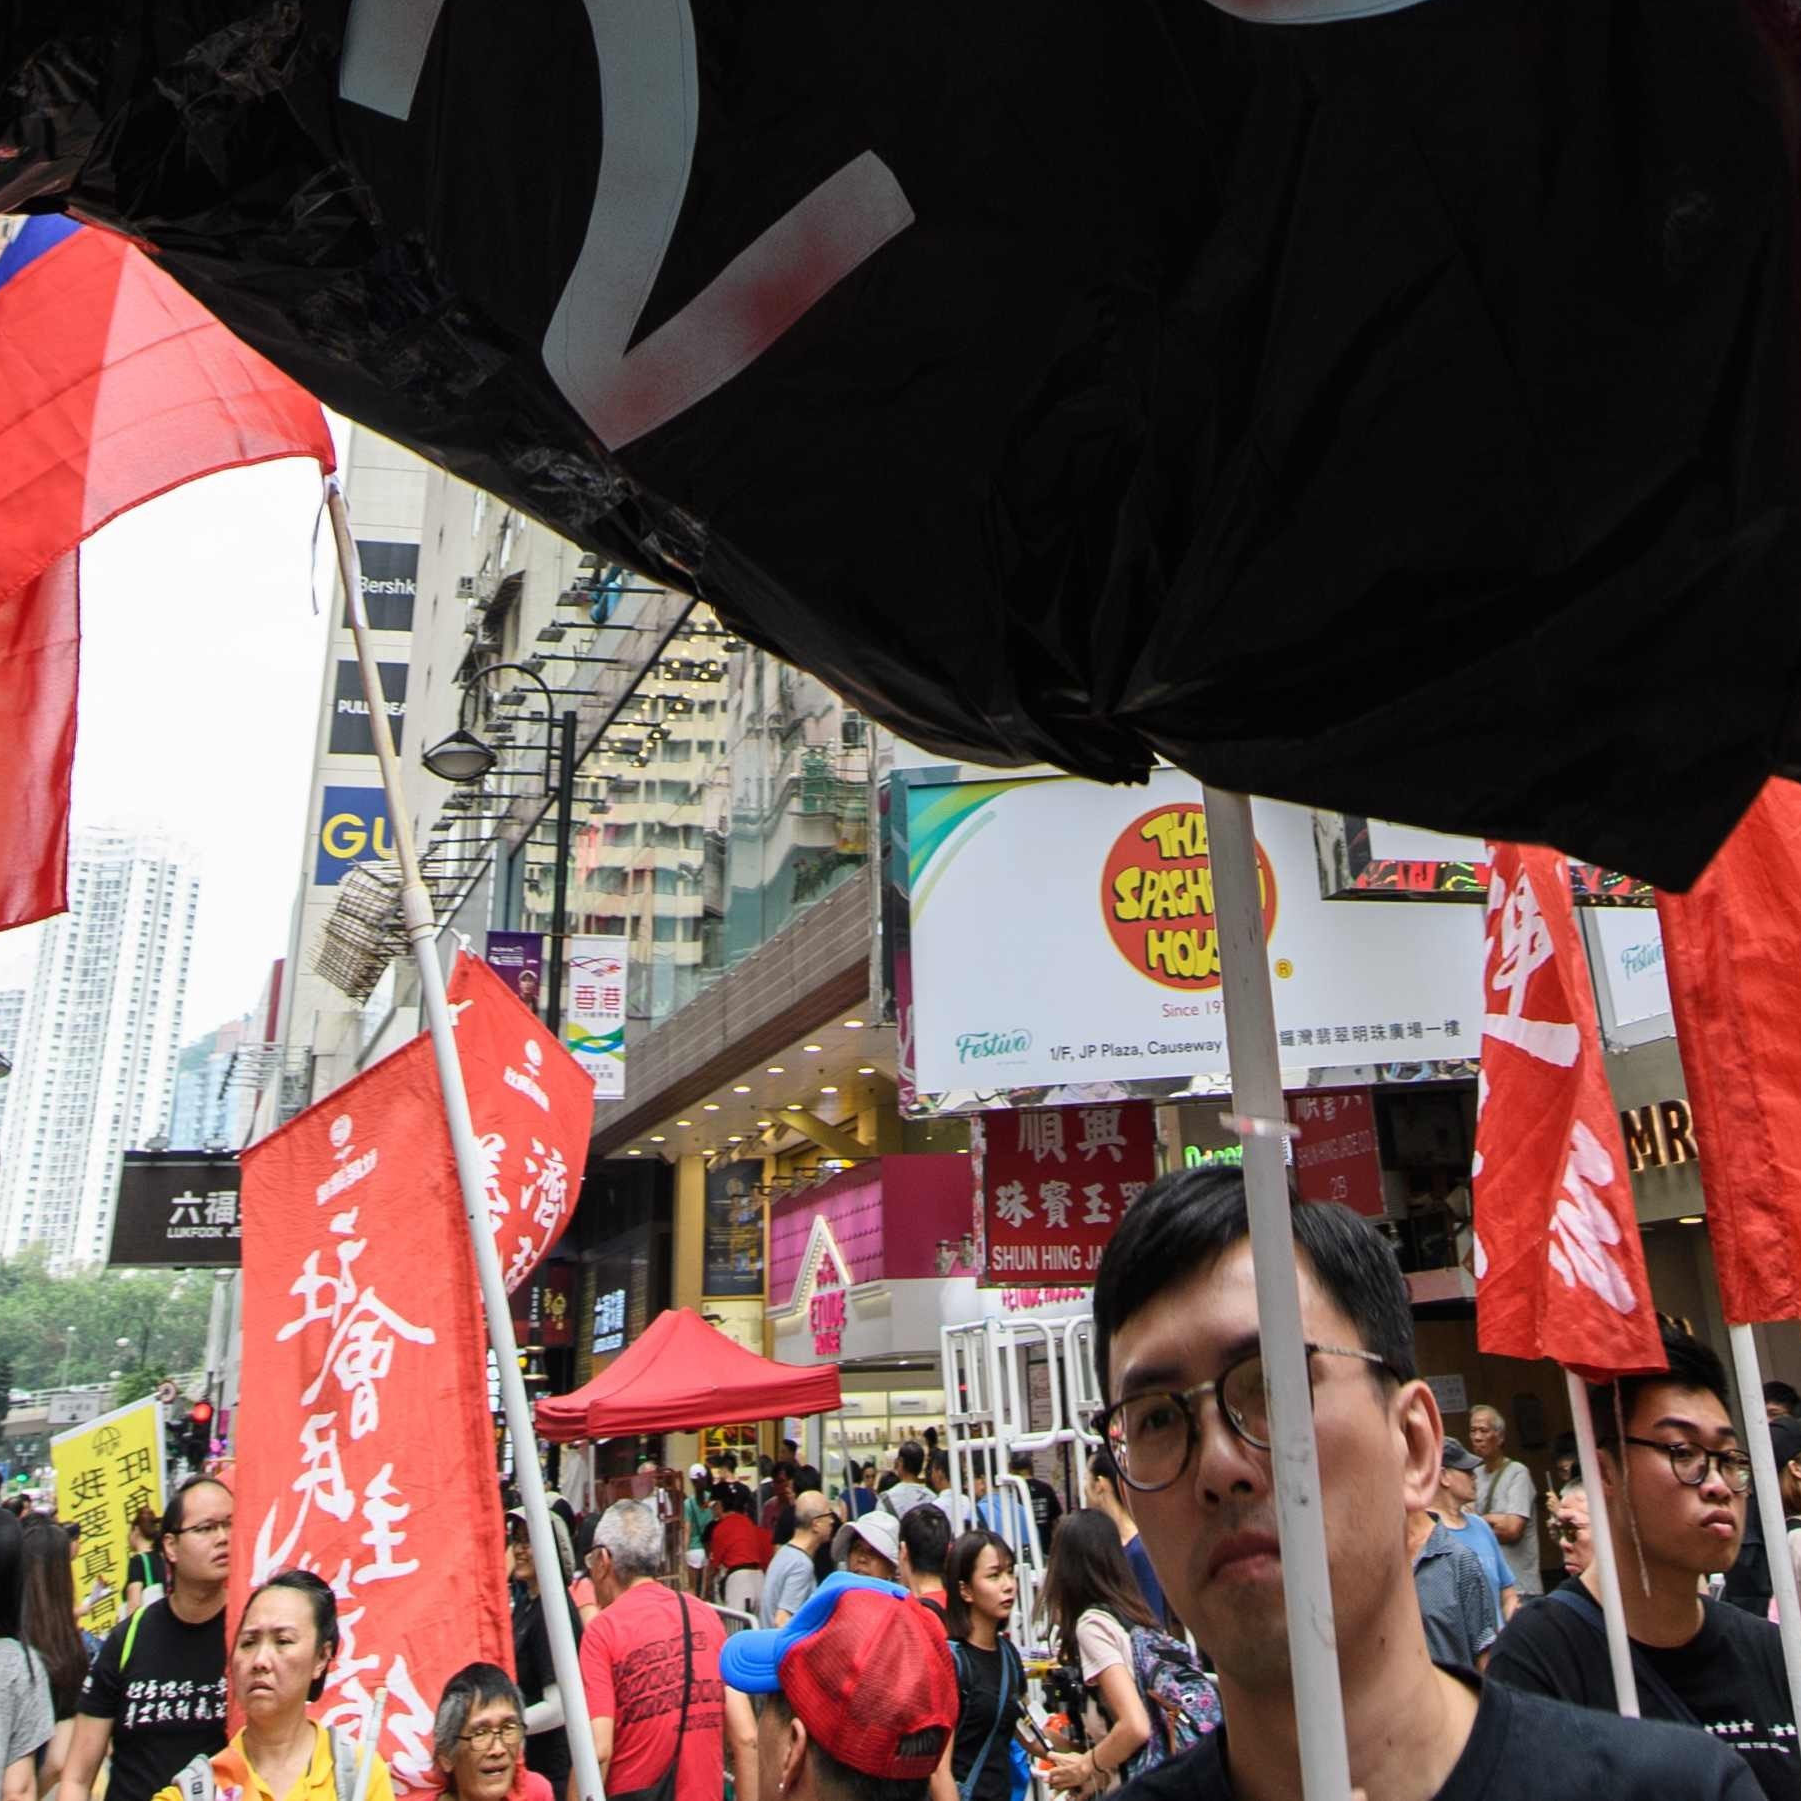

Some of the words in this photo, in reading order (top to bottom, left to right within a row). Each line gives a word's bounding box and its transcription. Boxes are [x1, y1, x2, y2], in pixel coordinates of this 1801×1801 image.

[1162, 1003, 1199, 1018] Since
[1048, 1043, 1075, 1062] 1/F,
[1078, 1041, 1097, 1060] JP
[1100, 1039, 1145, 1060] Plaza,
[1147, 1037, 1223, 1059] Causeway
[1017, 1107, 1128, 1164] 順興
[991, 1244, 1038, 1271] SHUN
[1041, 1244, 1082, 1271] HING
